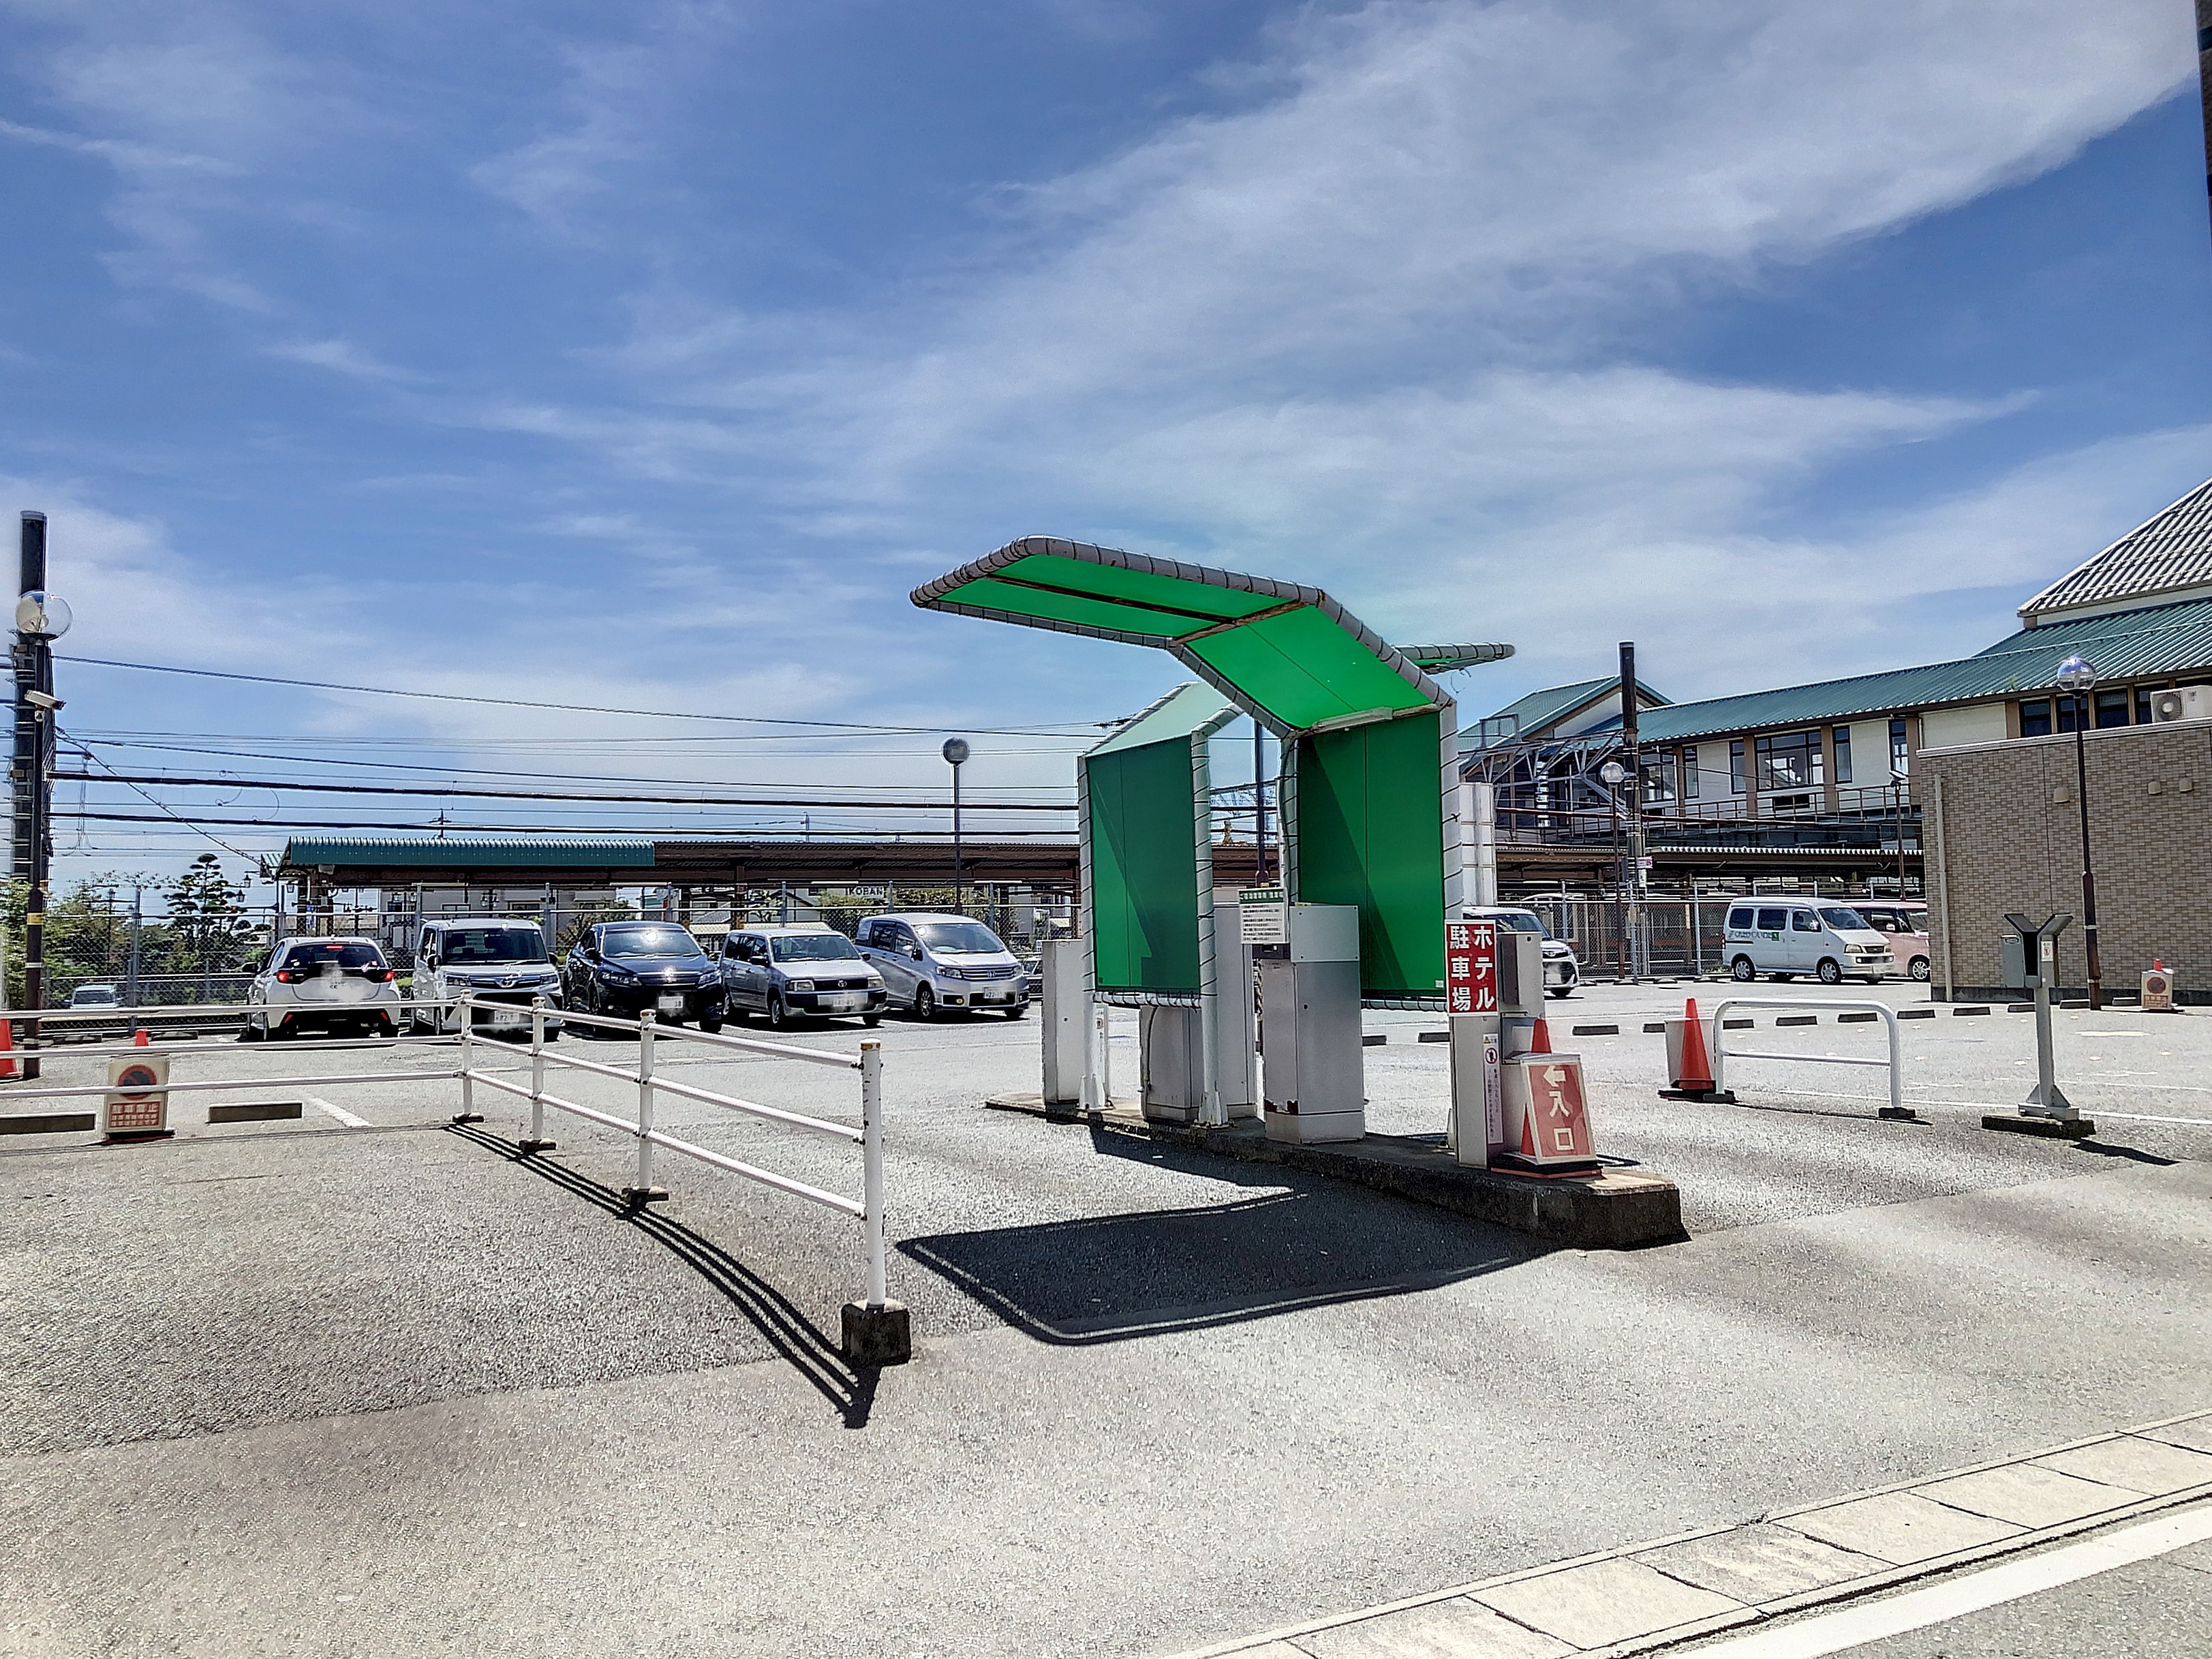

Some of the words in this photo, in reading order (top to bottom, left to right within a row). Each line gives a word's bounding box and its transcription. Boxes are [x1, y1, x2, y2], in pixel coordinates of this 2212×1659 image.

[1449, 926, 1471, 1011] 駐車場
[1473, 926, 1495, 1010] ホテル
[1549, 1091, 1574, 1151] 入口
